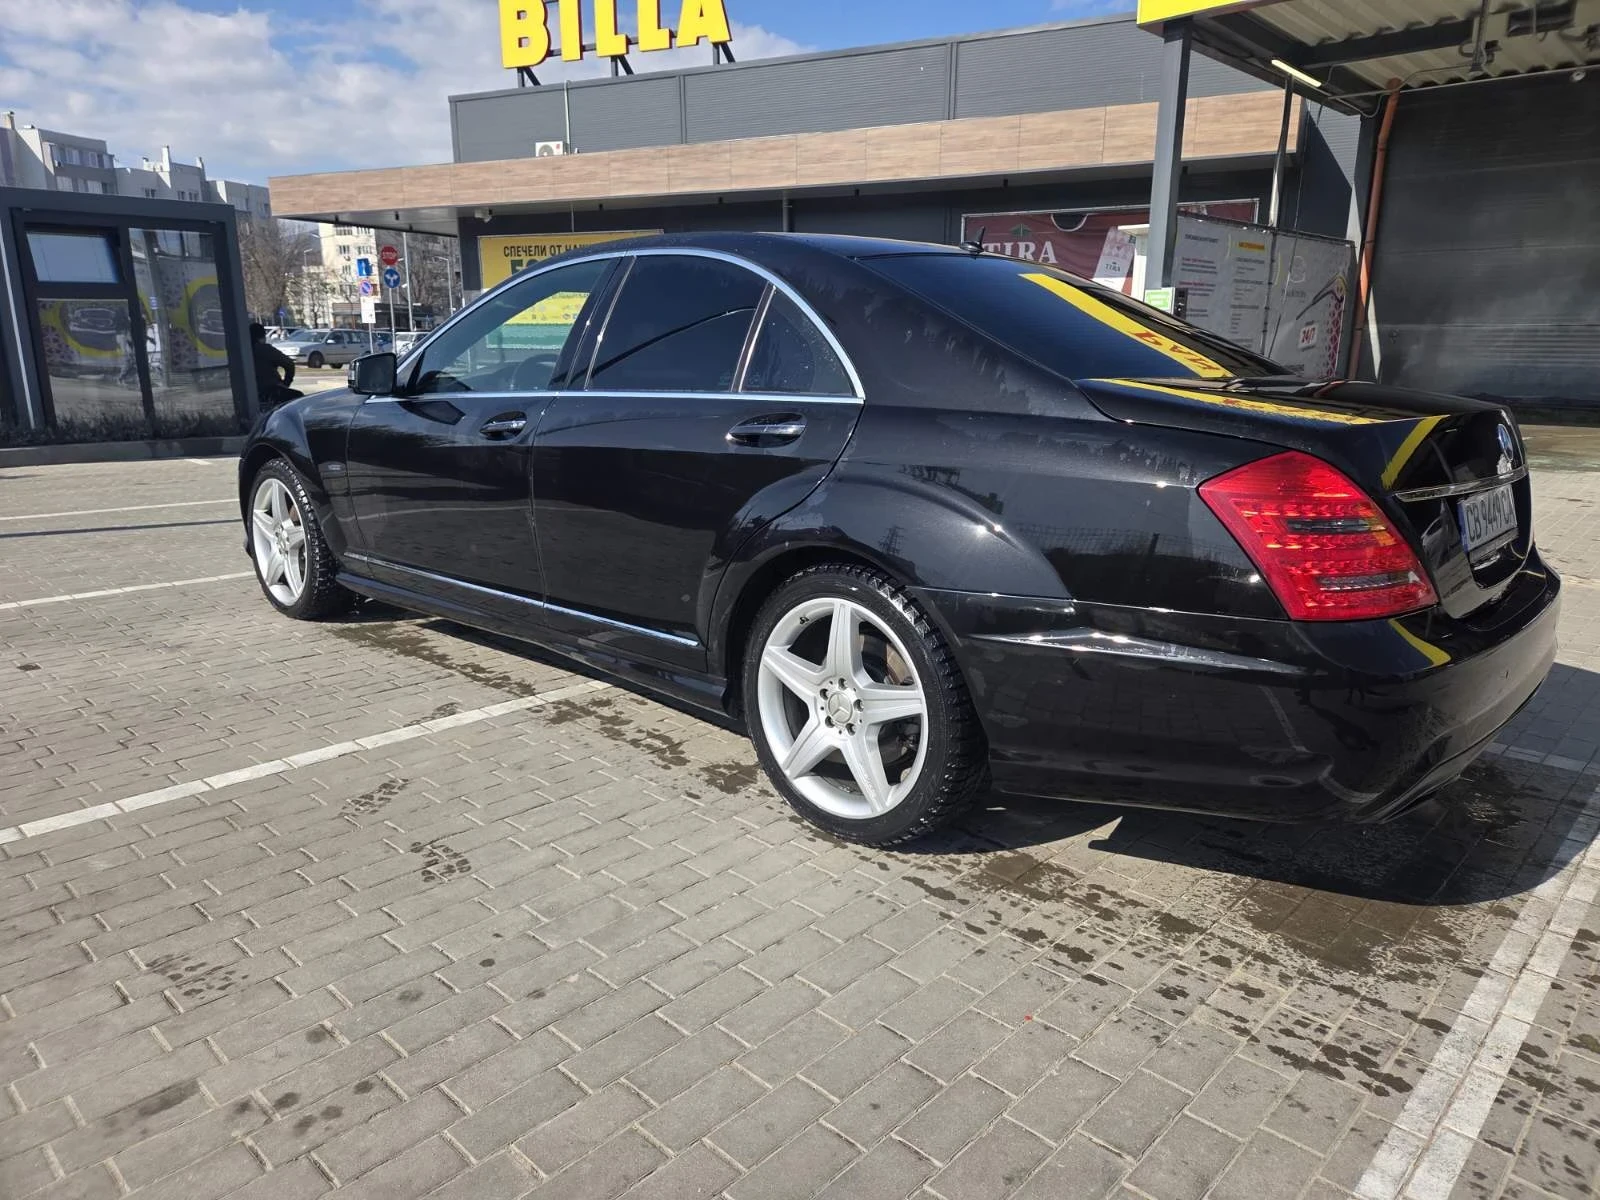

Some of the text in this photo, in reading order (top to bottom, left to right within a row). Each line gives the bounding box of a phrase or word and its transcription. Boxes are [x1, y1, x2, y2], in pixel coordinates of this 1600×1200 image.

[499, 0, 732, 68] BILLA
[503, 244, 547, 257] СПЕЧЕЛИ
[549, 244, 563, 255] ОТ
[982, 241, 1058, 263] TIRA
